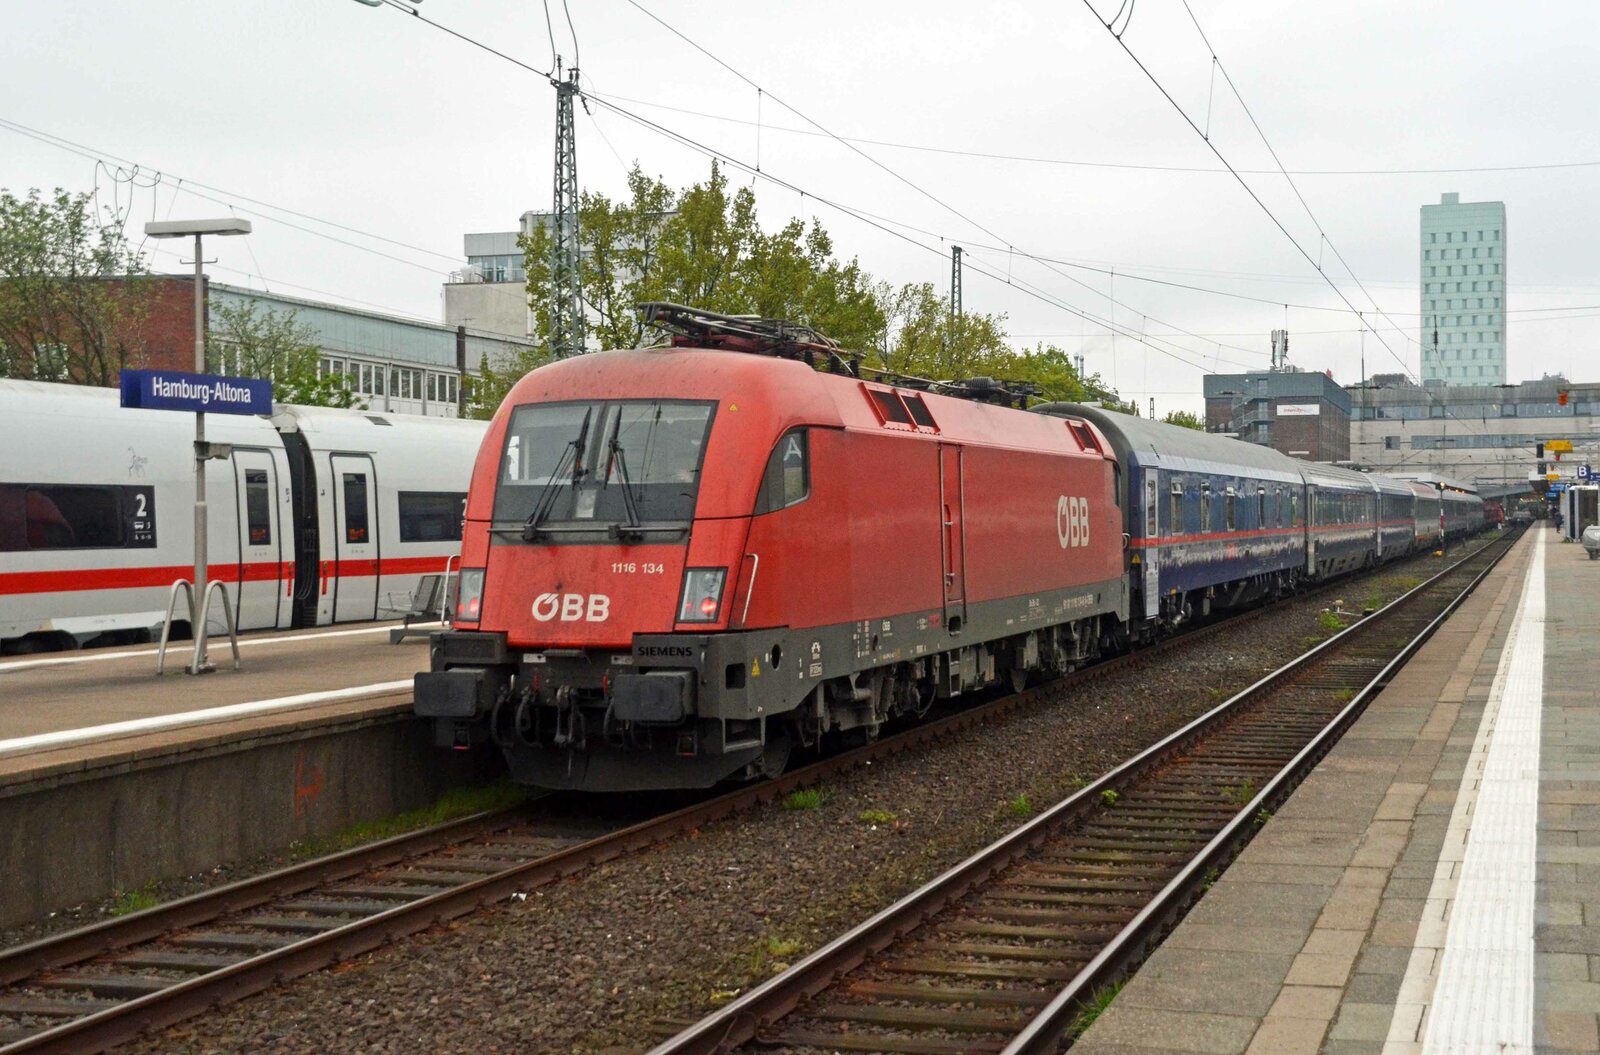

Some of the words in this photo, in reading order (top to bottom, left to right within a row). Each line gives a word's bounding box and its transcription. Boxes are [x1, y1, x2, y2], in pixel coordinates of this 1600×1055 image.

[153, 377, 251, 404] Hamburg-Altona
[1578, 466, 1587, 476] B
[135, 493, 147, 517] 2
[1057, 494, 1089, 549] ÖBB
[612, 563, 636, 573] 1116
[642, 563, 665, 574] 134
[531, 592, 611, 622] ÖBB
[638, 646, 693, 656] SIEMENS
